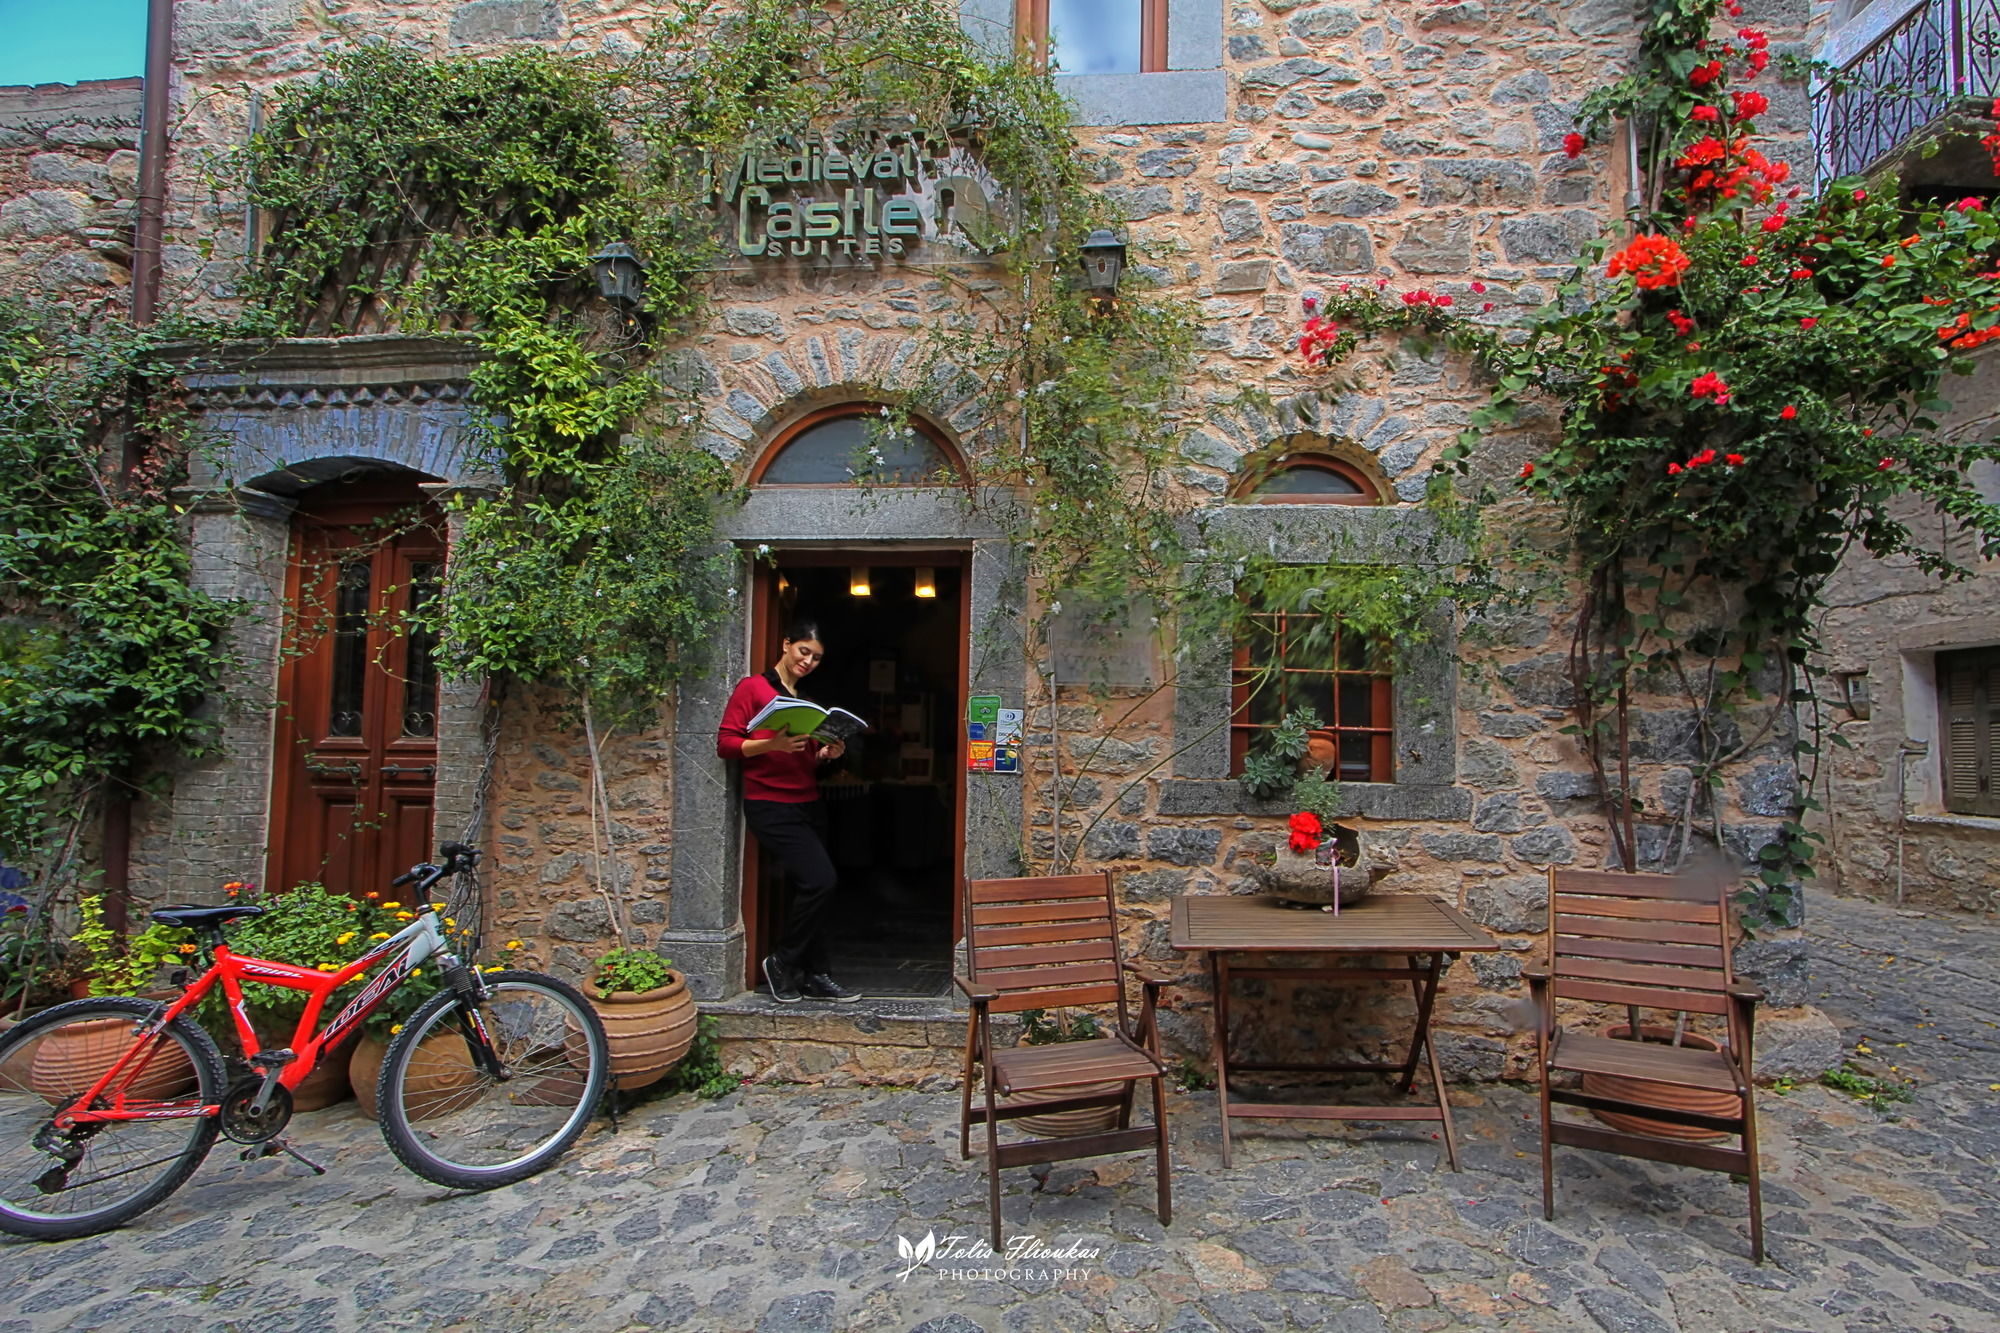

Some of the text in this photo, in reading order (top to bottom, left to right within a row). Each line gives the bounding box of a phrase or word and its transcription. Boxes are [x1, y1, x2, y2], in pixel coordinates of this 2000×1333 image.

[702, 141, 916, 204] Medieval
[739, 185, 919, 256] Castle
[767, 238, 904, 257] SUITES
